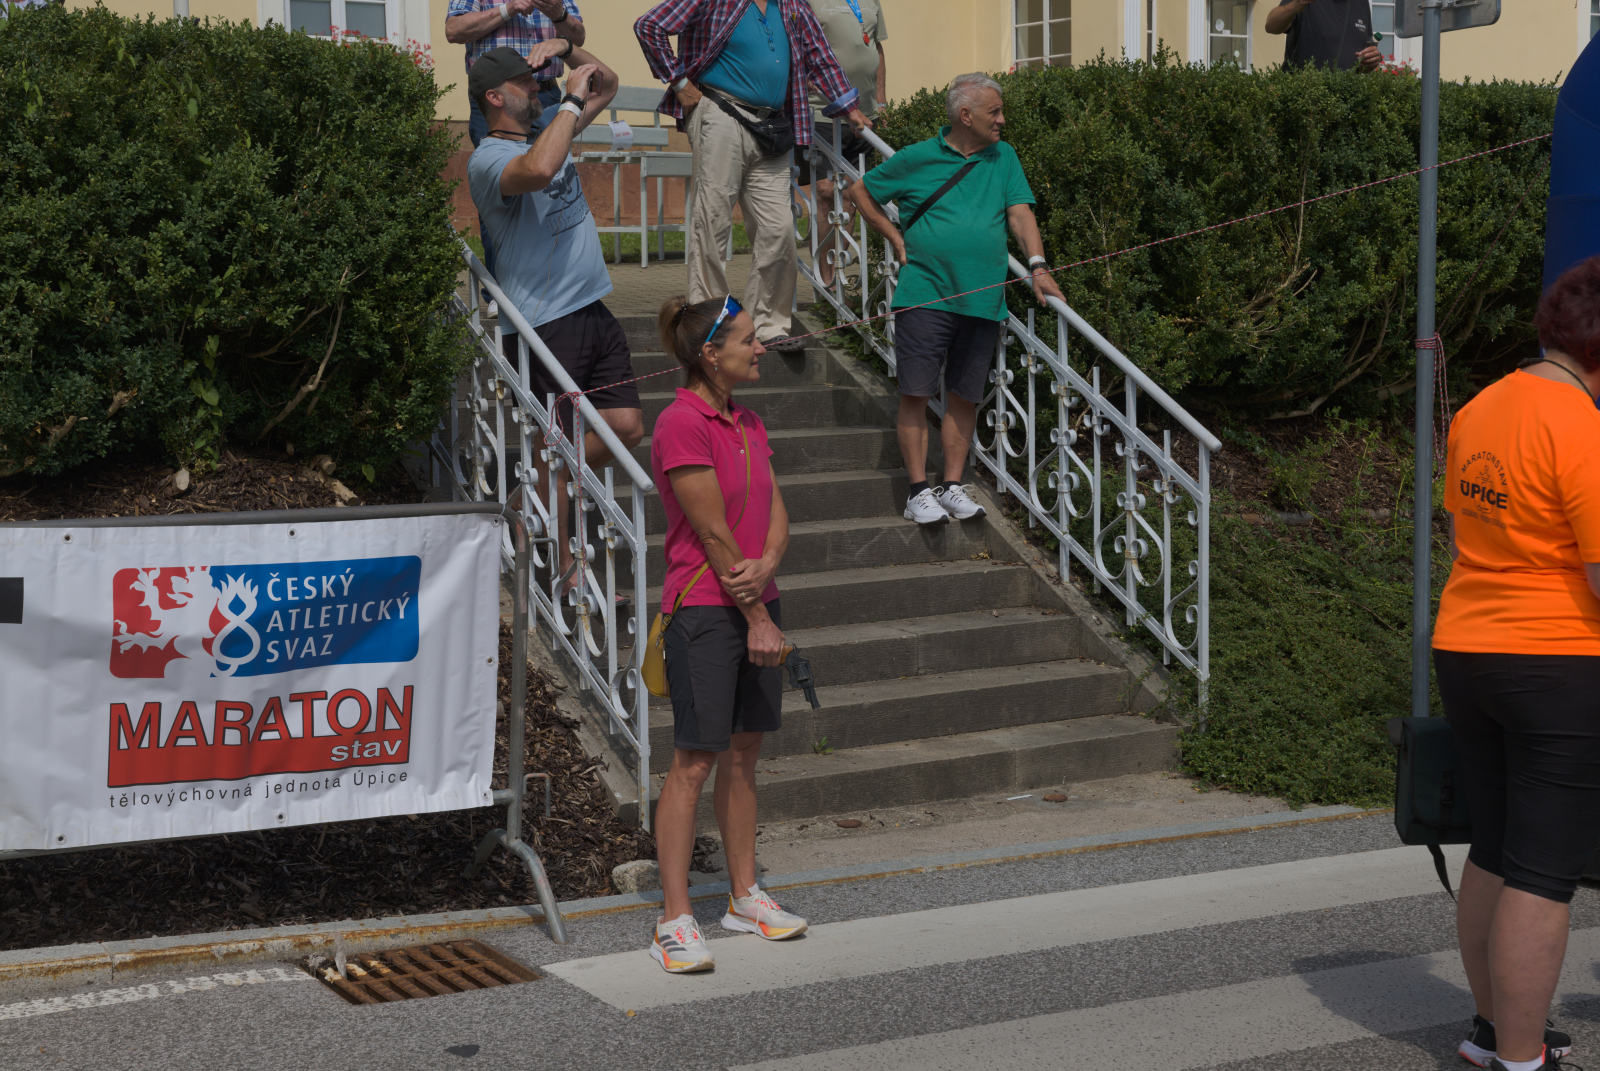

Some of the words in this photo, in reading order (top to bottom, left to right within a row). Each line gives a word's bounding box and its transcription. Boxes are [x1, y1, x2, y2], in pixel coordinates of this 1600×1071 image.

[1461, 451, 1507, 486] MARATONSTAV
[266, 567, 355, 602] ČESKÝ
[265, 591, 411, 633] ATLETICKÝ
[265, 633, 334, 663] SVAZ
[108, 684, 415, 752] MARATON
[329, 738, 403, 763] stav
[109, 781, 253, 808] tělovýchovná
[265, 775, 342, 799] jednota
[352, 769, 409, 789] Úpice
